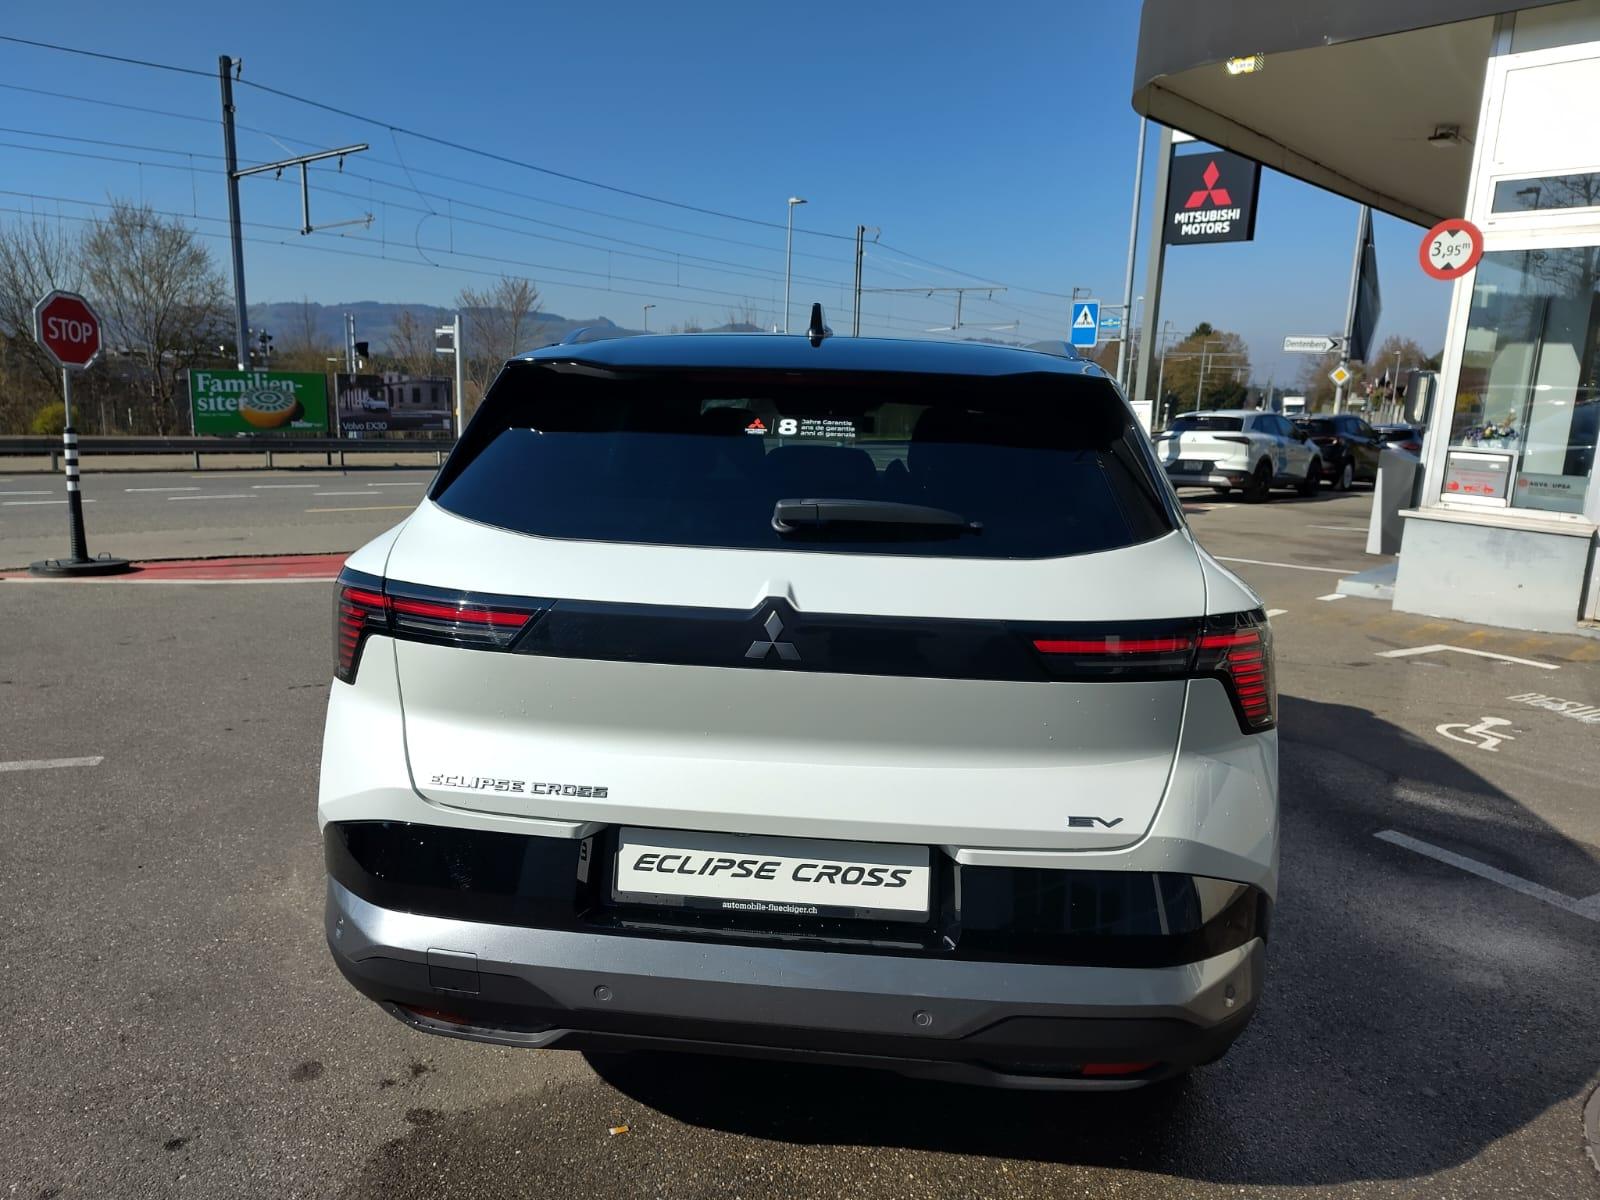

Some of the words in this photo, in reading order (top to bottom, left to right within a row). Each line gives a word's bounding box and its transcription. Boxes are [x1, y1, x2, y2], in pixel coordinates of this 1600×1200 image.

[1174, 208, 1241, 224] MITSUBISHI
[1181, 221, 1231, 235] MOTORS
[48, 316, 93, 344] STOP
[196, 373, 303, 393] Familien-
[342, 421, 364, 430] Volvo
[366, 421, 388, 430] EX30
[778, 418, 798, 435] 8
[801, 418, 822, 426] Jahre
[430, 773, 525, 792] ECLIPSE
[530, 781, 608, 798] CROSS
[1067, 815, 1124, 828] EV
[632, 853, 781, 880] ECLIPSE
[791, 863, 912, 888] CROSS
[721, 900, 819, 915] automobile-flueckiger.ch
